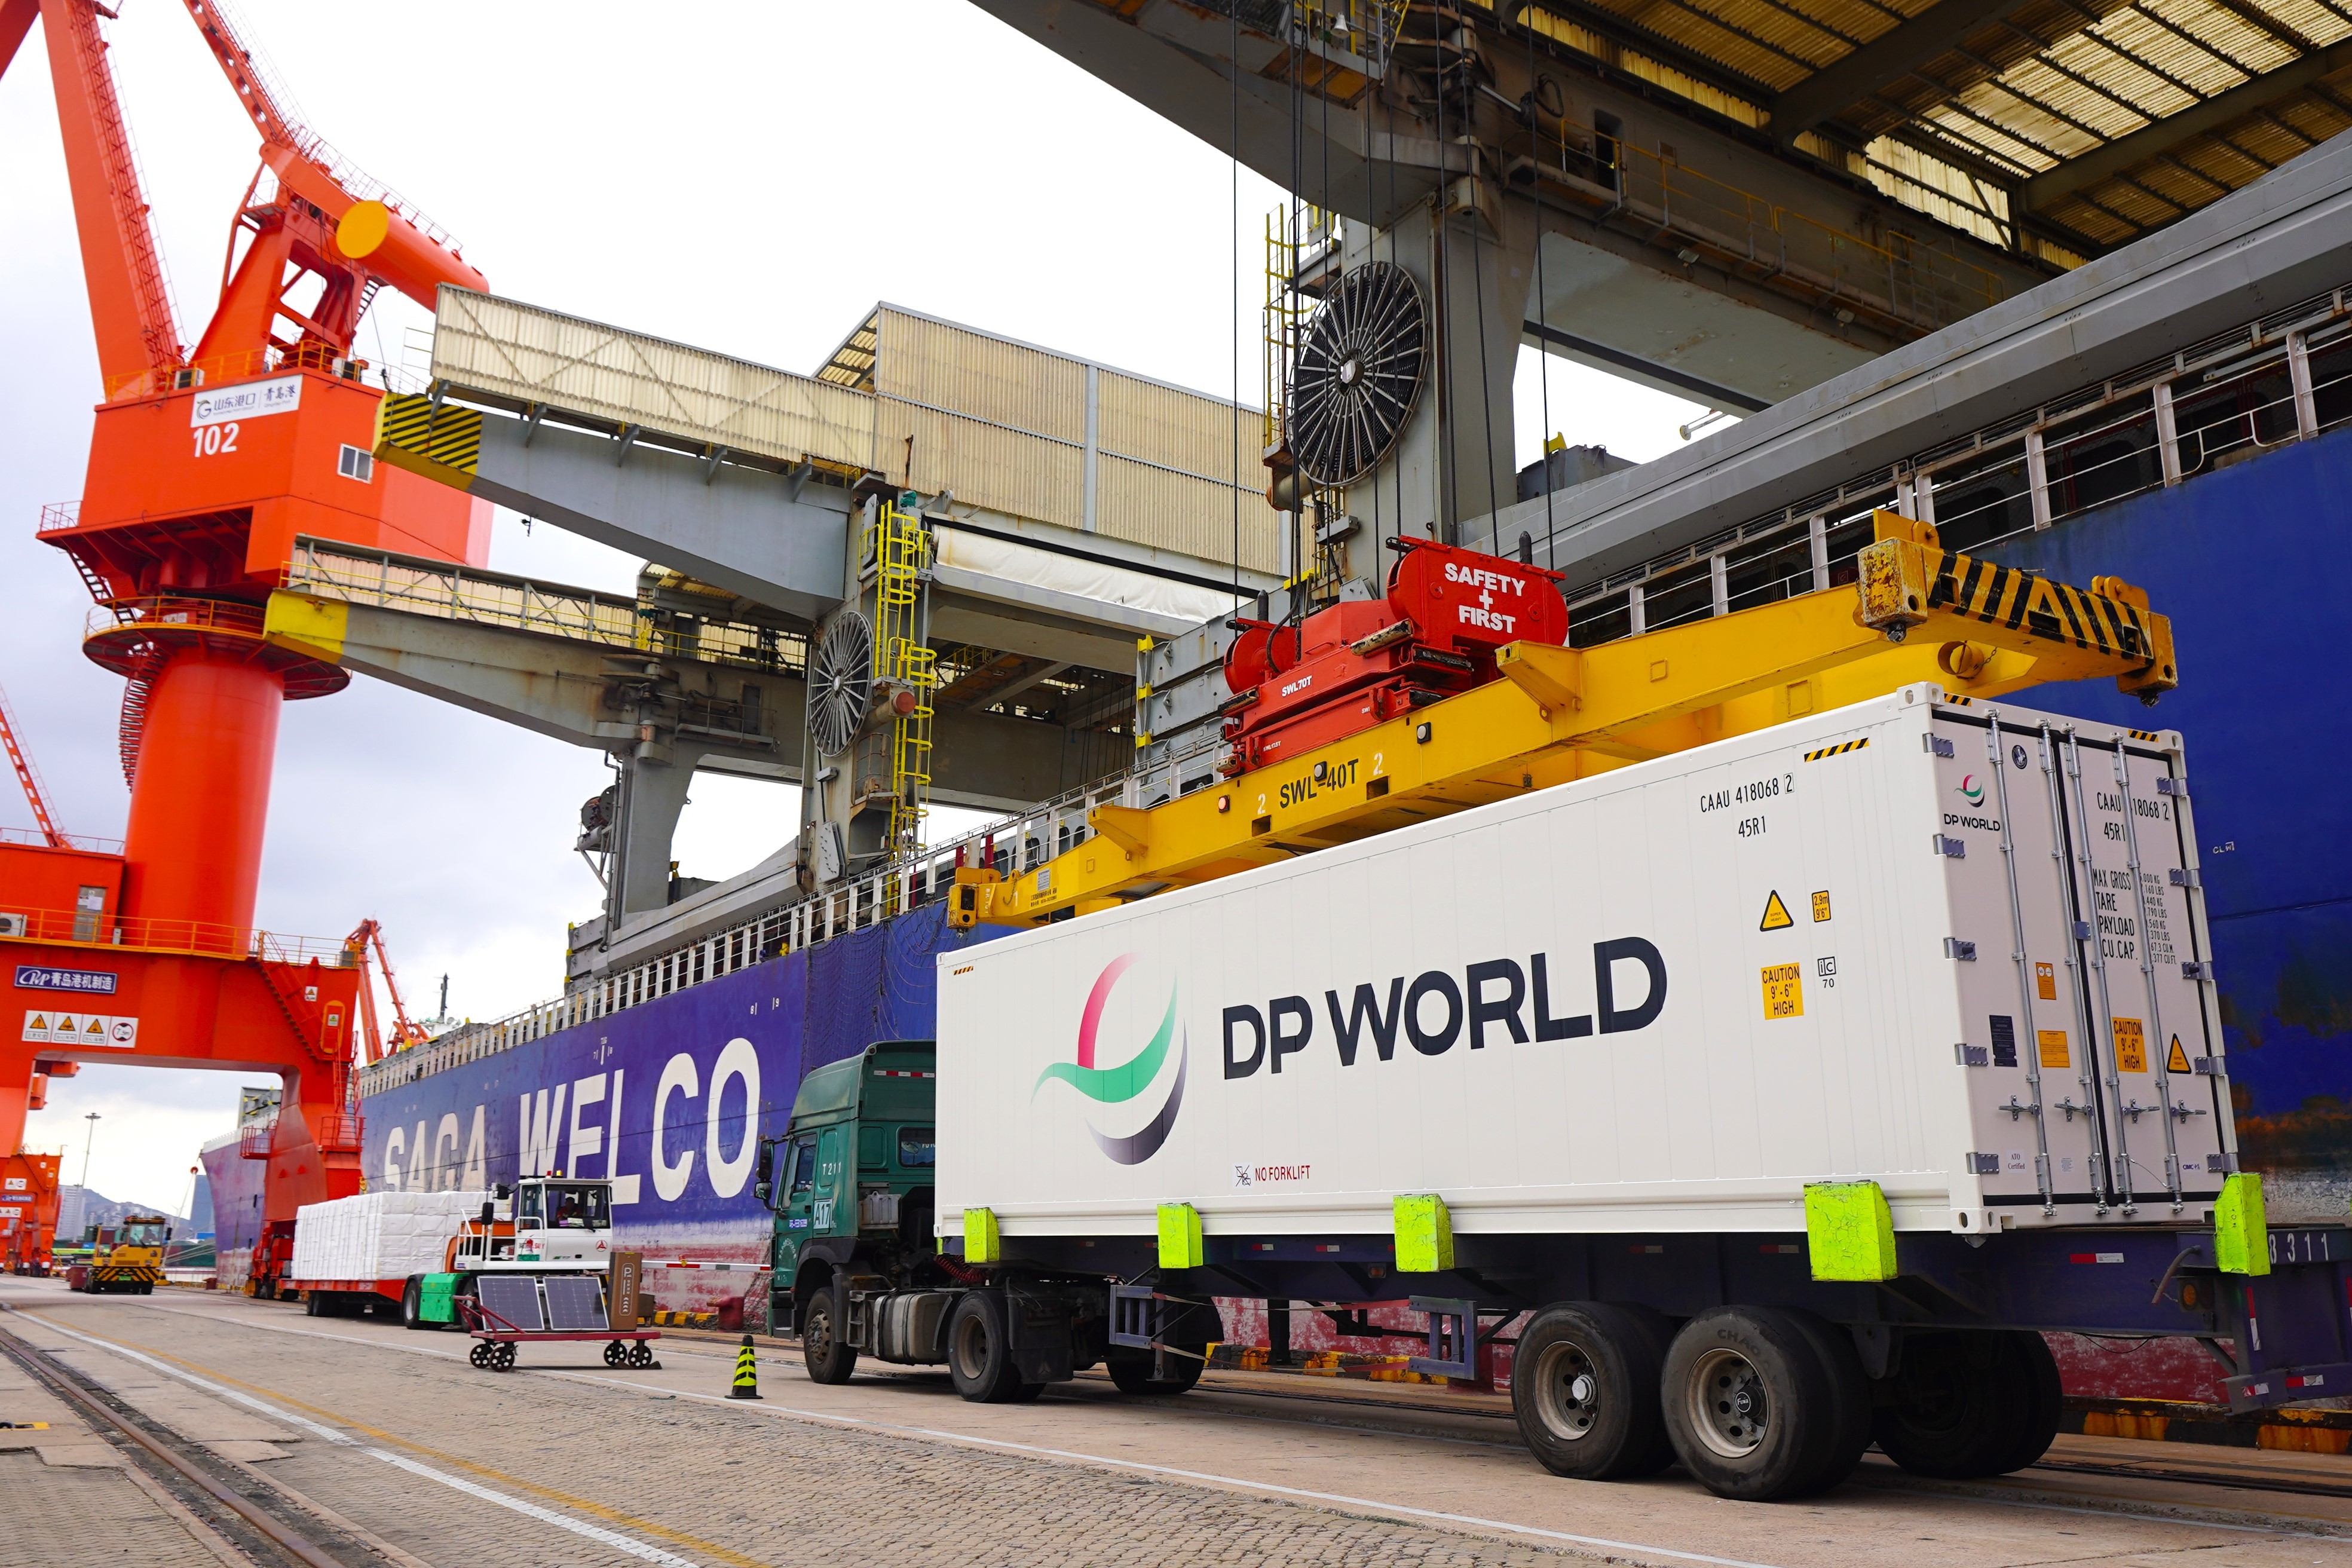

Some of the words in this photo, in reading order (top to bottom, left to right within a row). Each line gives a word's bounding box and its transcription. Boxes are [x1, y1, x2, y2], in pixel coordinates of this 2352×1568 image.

[193, 422, 239, 458] 102
[1444, 562, 1526, 597] SAFETY
[1458, 604, 1516, 634] FIRST
[1281, 675, 1313, 697] SWL70T
[1373, 752, 1383, 776] 2
[1257, 793, 1266, 815] 2
[1701, 789, 1730, 813] CAAU
[1735, 777, 1779, 804] 418068
[1785, 774, 1793, 792] 2
[2097, 792, 2121, 812] CAAU
[2131, 798, 2160, 819] 18068
[2163, 803, 2169, 820] 2
[1738, 815, 1766, 838] 45R1
[1944, 813, 1959, 825] DP
[1960, 815, 2001, 831] WORLD
[2104, 822, 2126, 841] 45R1
[2093, 868, 2108, 888] MAX
[2110, 870, 2132, 890] GROSS
[2155, 886, 2164, 896] LBS
[2096, 892, 2117, 912] TARE
[2158, 908, 2167, 918] LBS
[2099, 915, 2134, 936] PAYLOAD
[2161, 931, 2170, 941] LBS
[51, 972, 113, 991] 青岛港机制造
[1762, 965, 1800, 984] CAUTION
[1822, 978, 1835, 988] 70
[1223, 994, 1313, 1080] DP
[1324, 936, 1667, 1067] WORLD
[1773, 1000, 1794, 1016] HIGH
[2114, 1020, 2143, 1036] CAUTION
[2124, 1054, 2140, 1069] HIGH
[519, 1037, 761, 1205] WELCO
[1255, 1166, 1267, 1181] NO
[1268, 1165, 1310, 1181] FORKLIFT
[814, 1203, 831, 1226] A17
